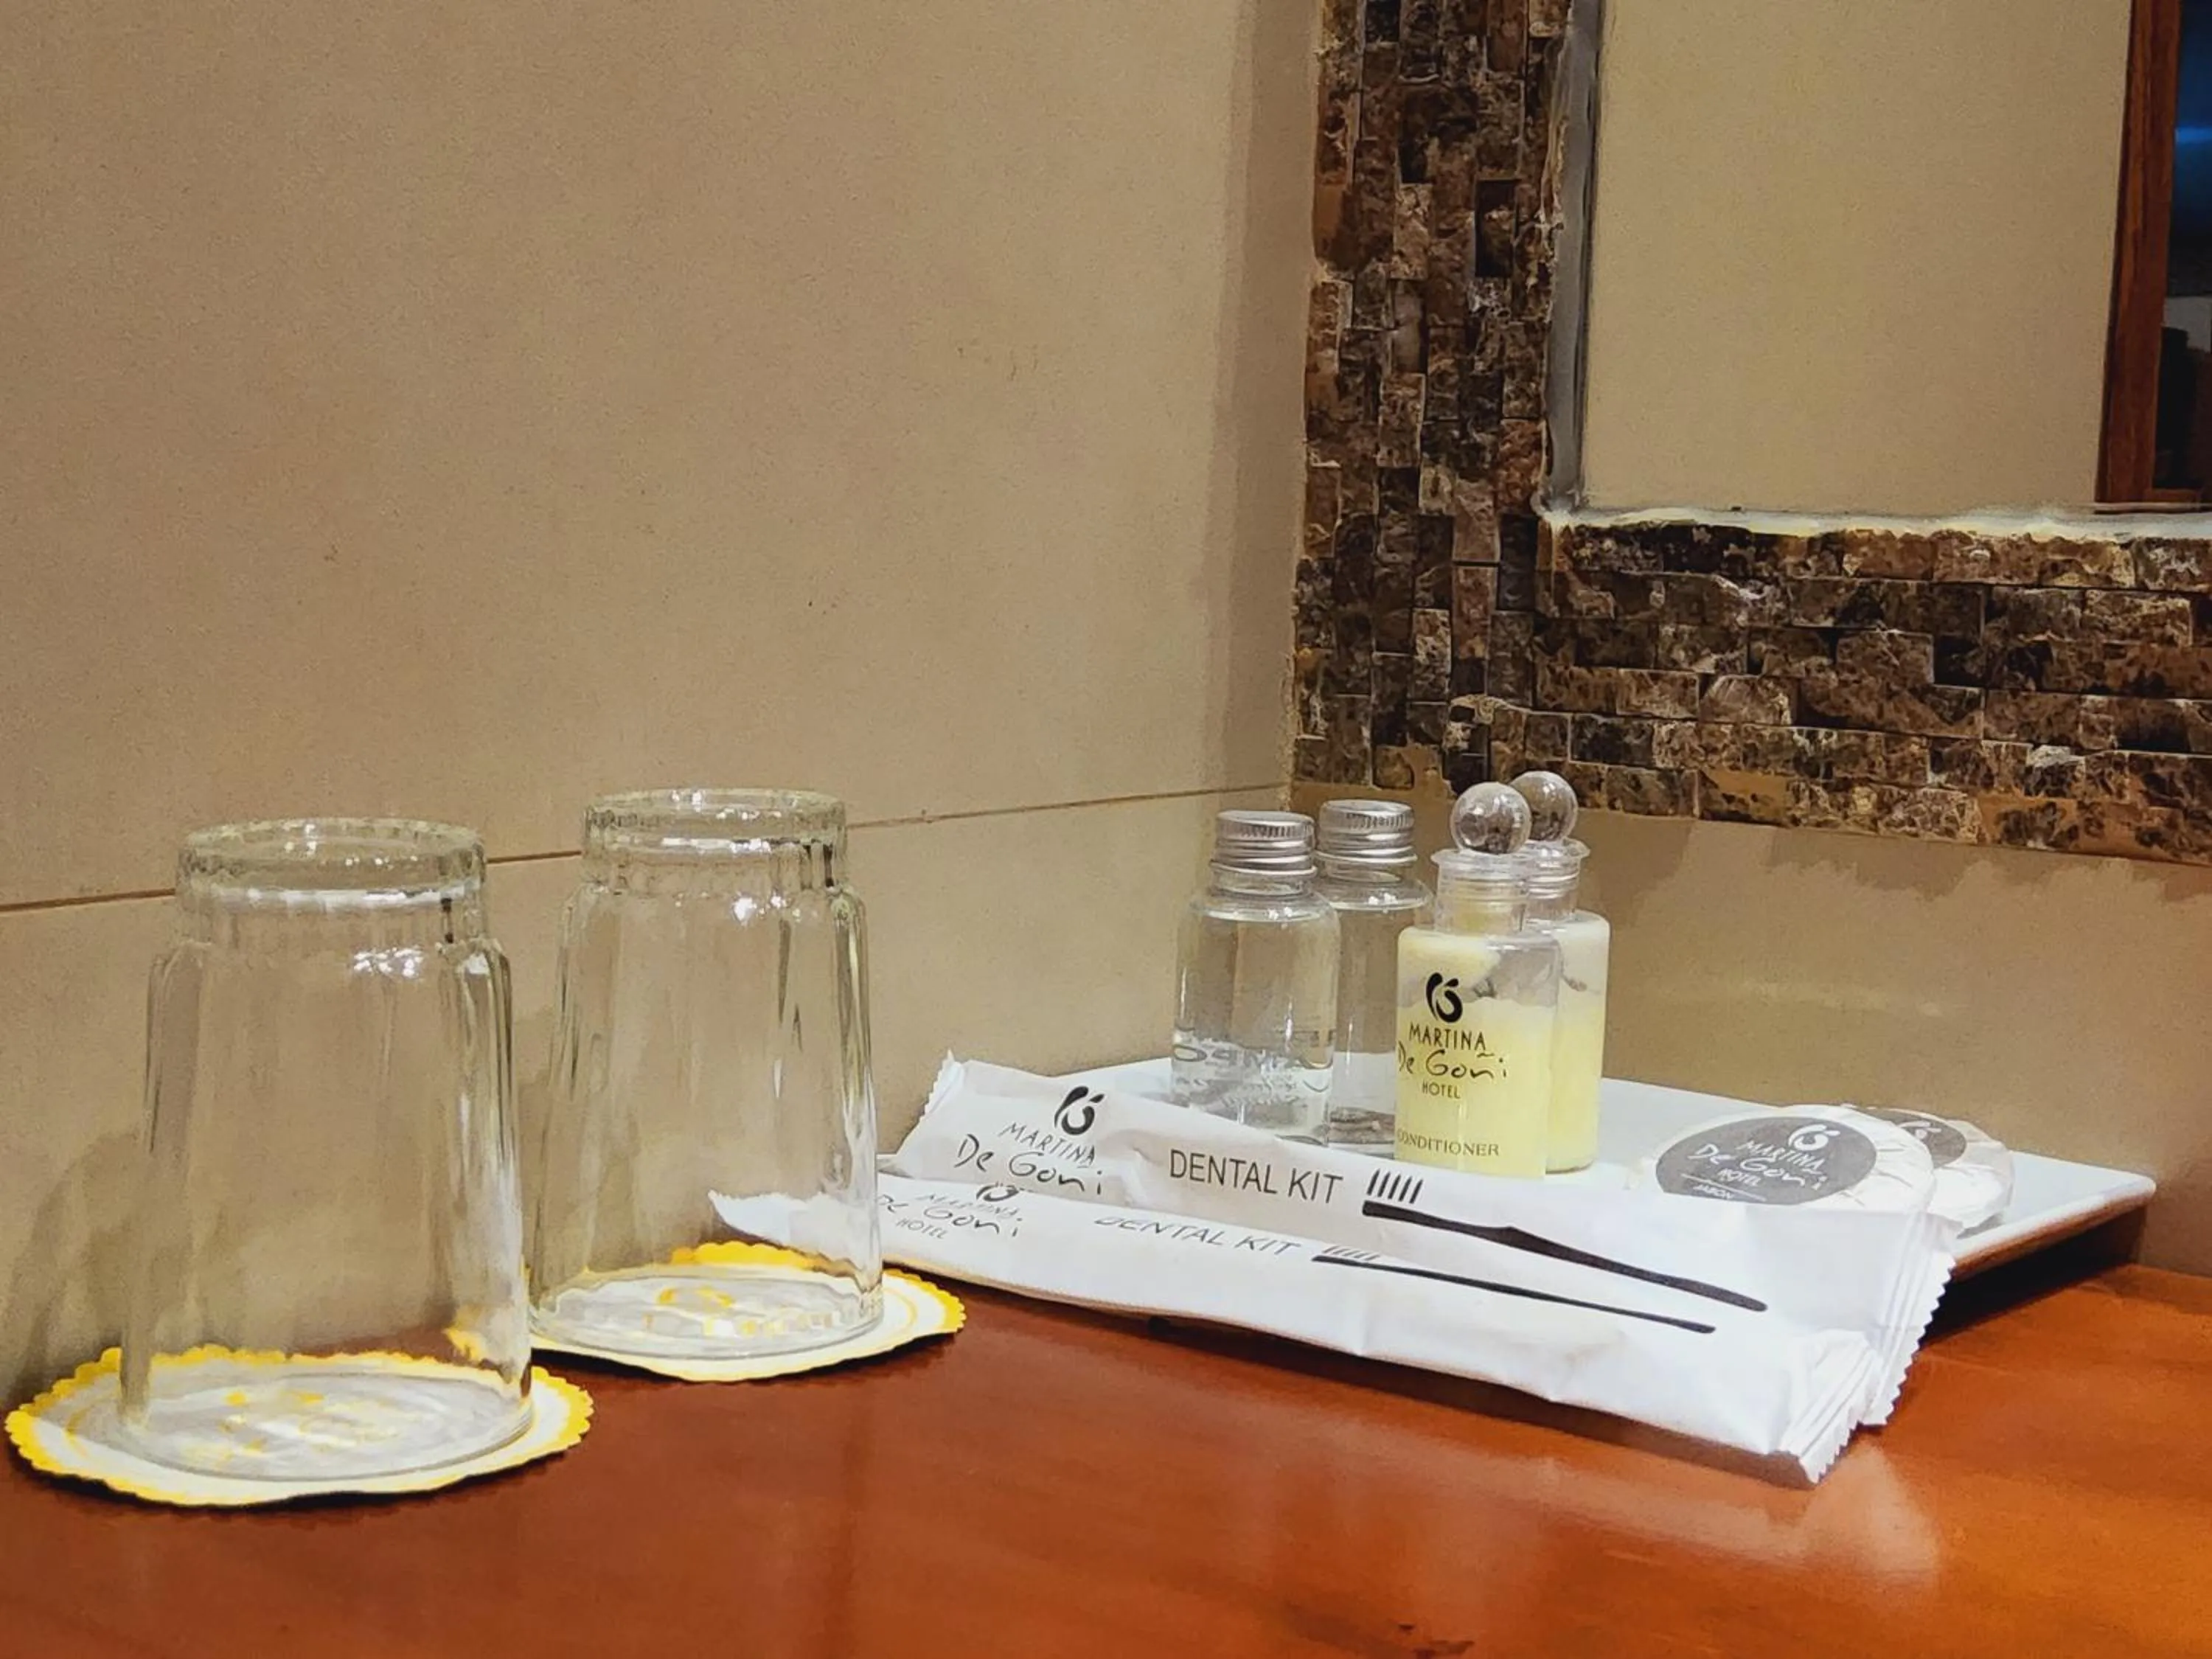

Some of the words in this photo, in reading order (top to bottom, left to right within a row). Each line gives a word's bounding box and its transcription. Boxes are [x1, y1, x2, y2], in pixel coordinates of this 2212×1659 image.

[1409, 1021, 1486, 1050] MARTINA
[1422, 1080, 1461, 1099] HOTEL
[954, 1133, 994, 1172] De
[998, 1121, 1095, 1166] MARTINA
[1397, 1128, 1500, 1157] CONDITIONER
[1687, 1143, 1735, 1165] De
[1736, 1141, 1826, 1172] MARTINA
[1170, 1149, 1277, 1194] DENTAL
[1287, 1167, 1344, 1204] KIT
[895, 1217, 948, 1239] HOTEL
[1094, 1215, 1225, 1246] DENTAL
[1234, 1236, 1301, 1255] KIT
